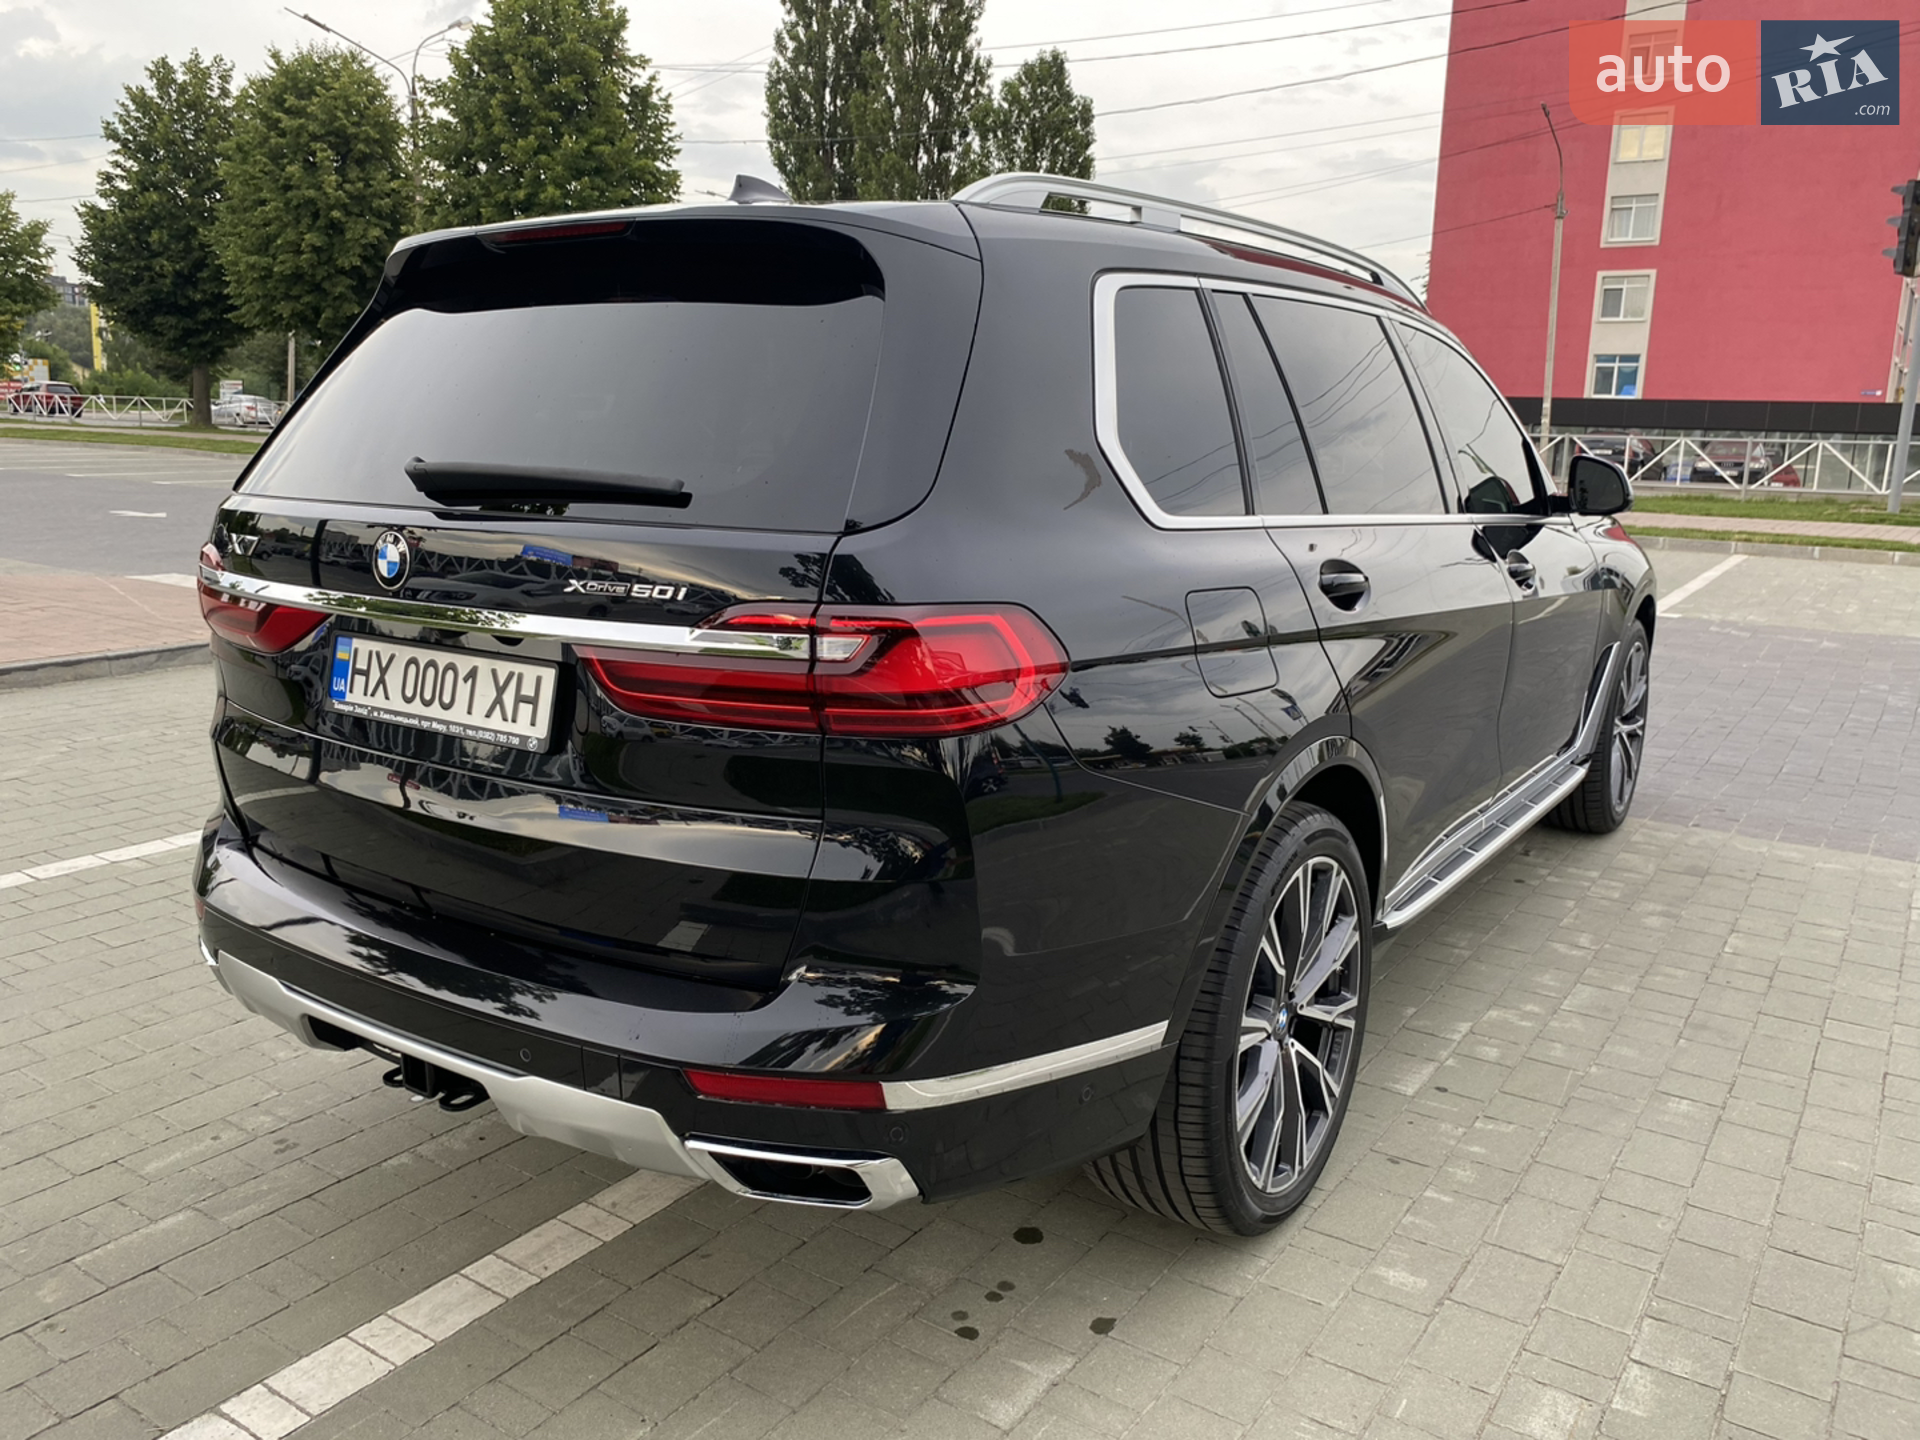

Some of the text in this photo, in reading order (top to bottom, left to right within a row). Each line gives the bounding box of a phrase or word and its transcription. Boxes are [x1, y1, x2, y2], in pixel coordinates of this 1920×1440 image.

[332, 677, 346, 692] UA
[349, 647, 543, 727] HX 0001 XH
